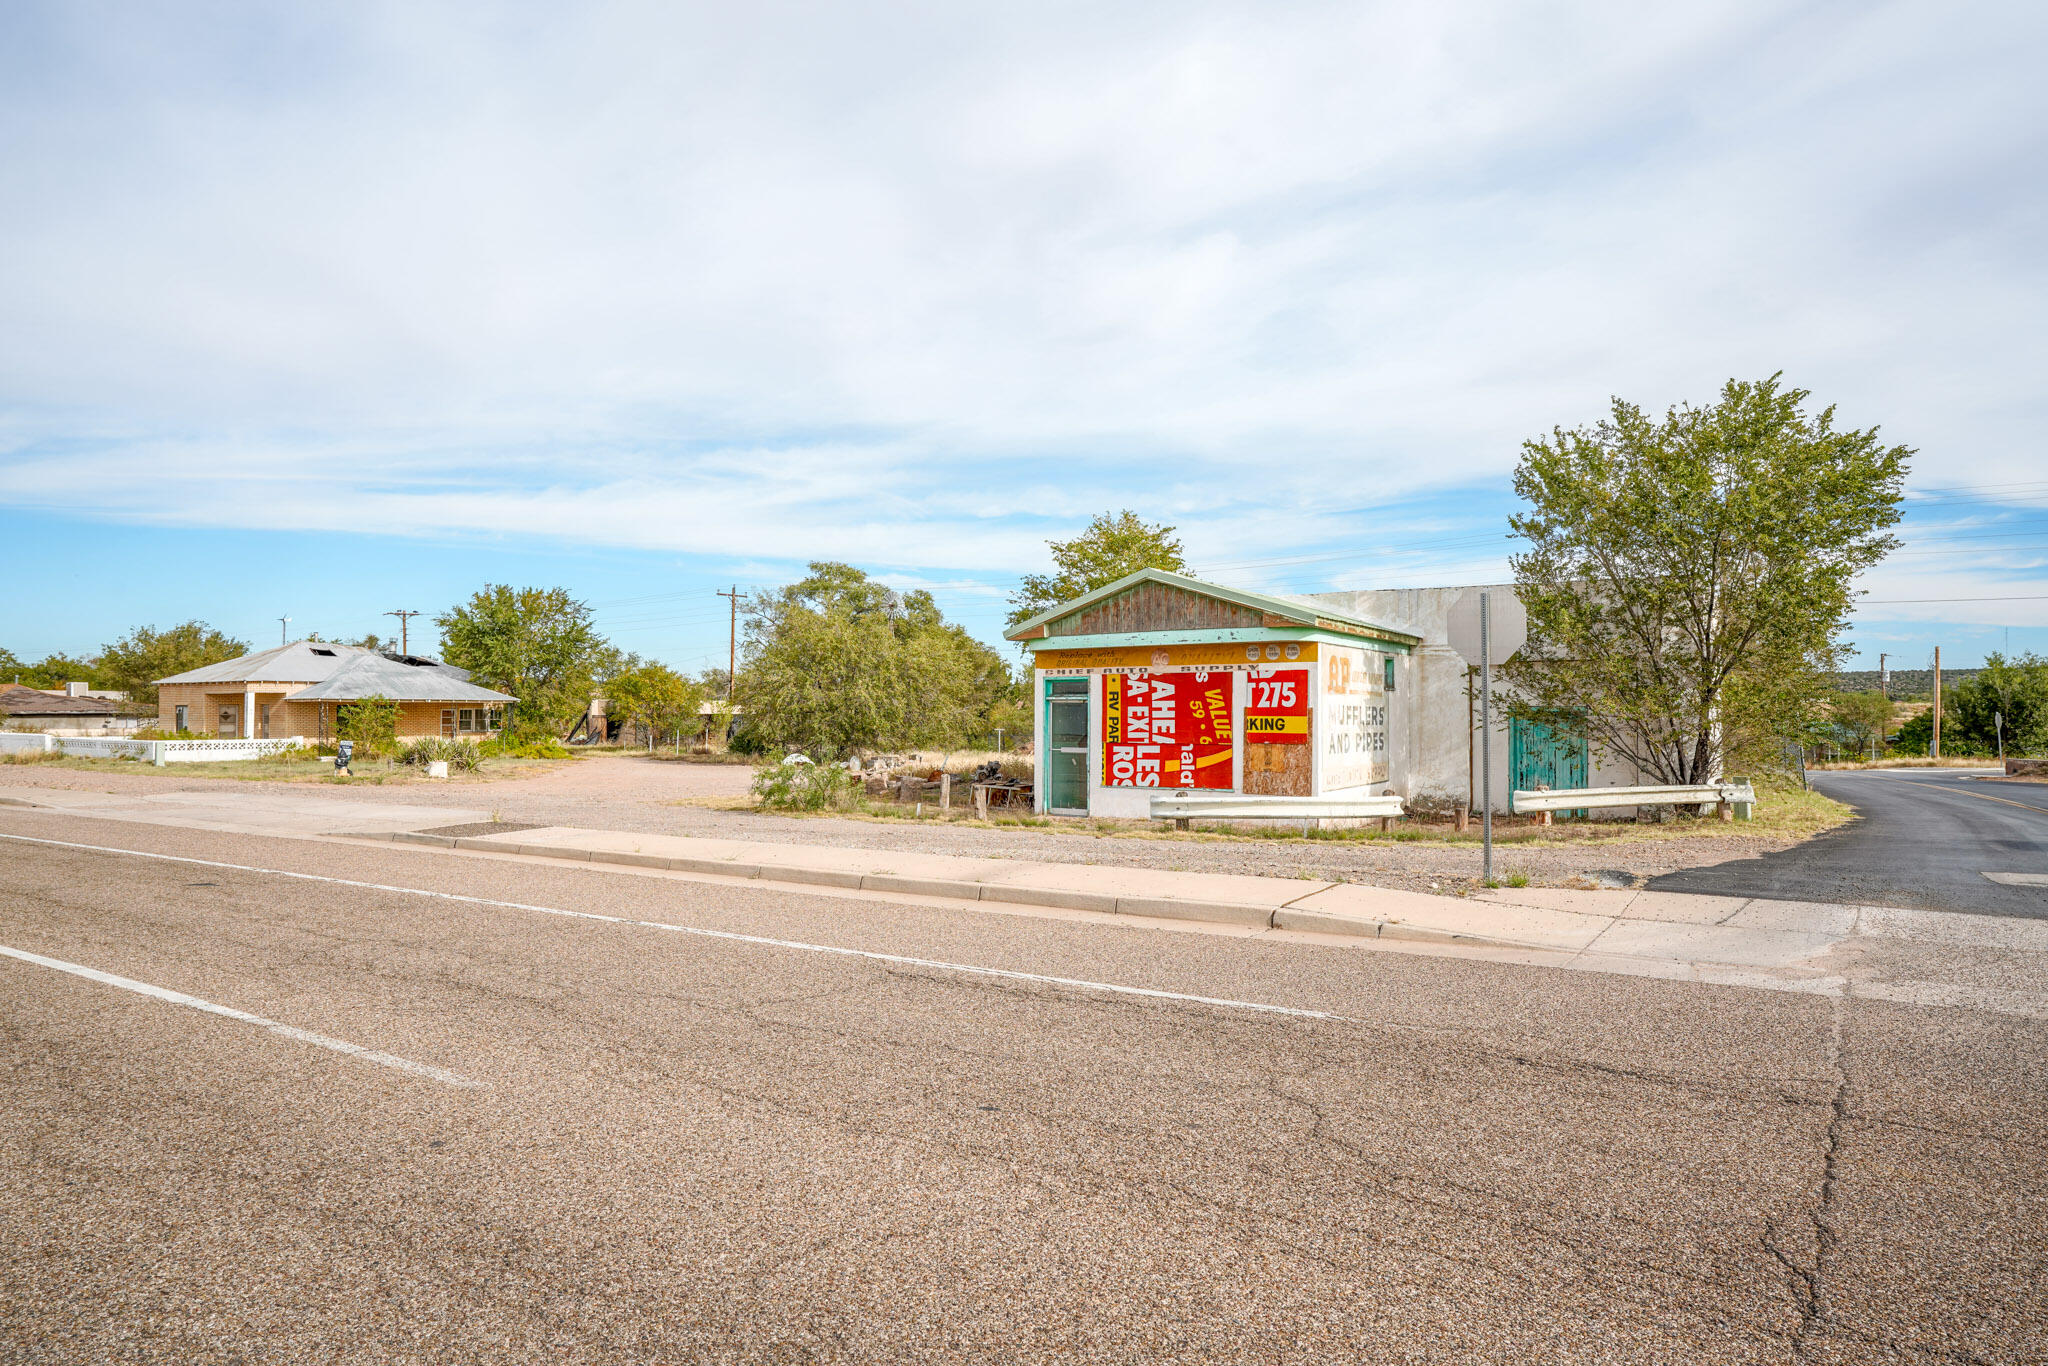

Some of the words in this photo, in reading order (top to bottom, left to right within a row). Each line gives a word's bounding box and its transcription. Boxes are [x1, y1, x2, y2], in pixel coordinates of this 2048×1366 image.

[1181, 664, 1259, 672] SUPPLY
[1108, 691, 1119, 711] RV
[1257, 681, 1296, 708] 275
[1246, 718, 1285, 731] KING
[1328, 732, 1351, 755] AND
[1355, 731, 1385, 752] PIPES
